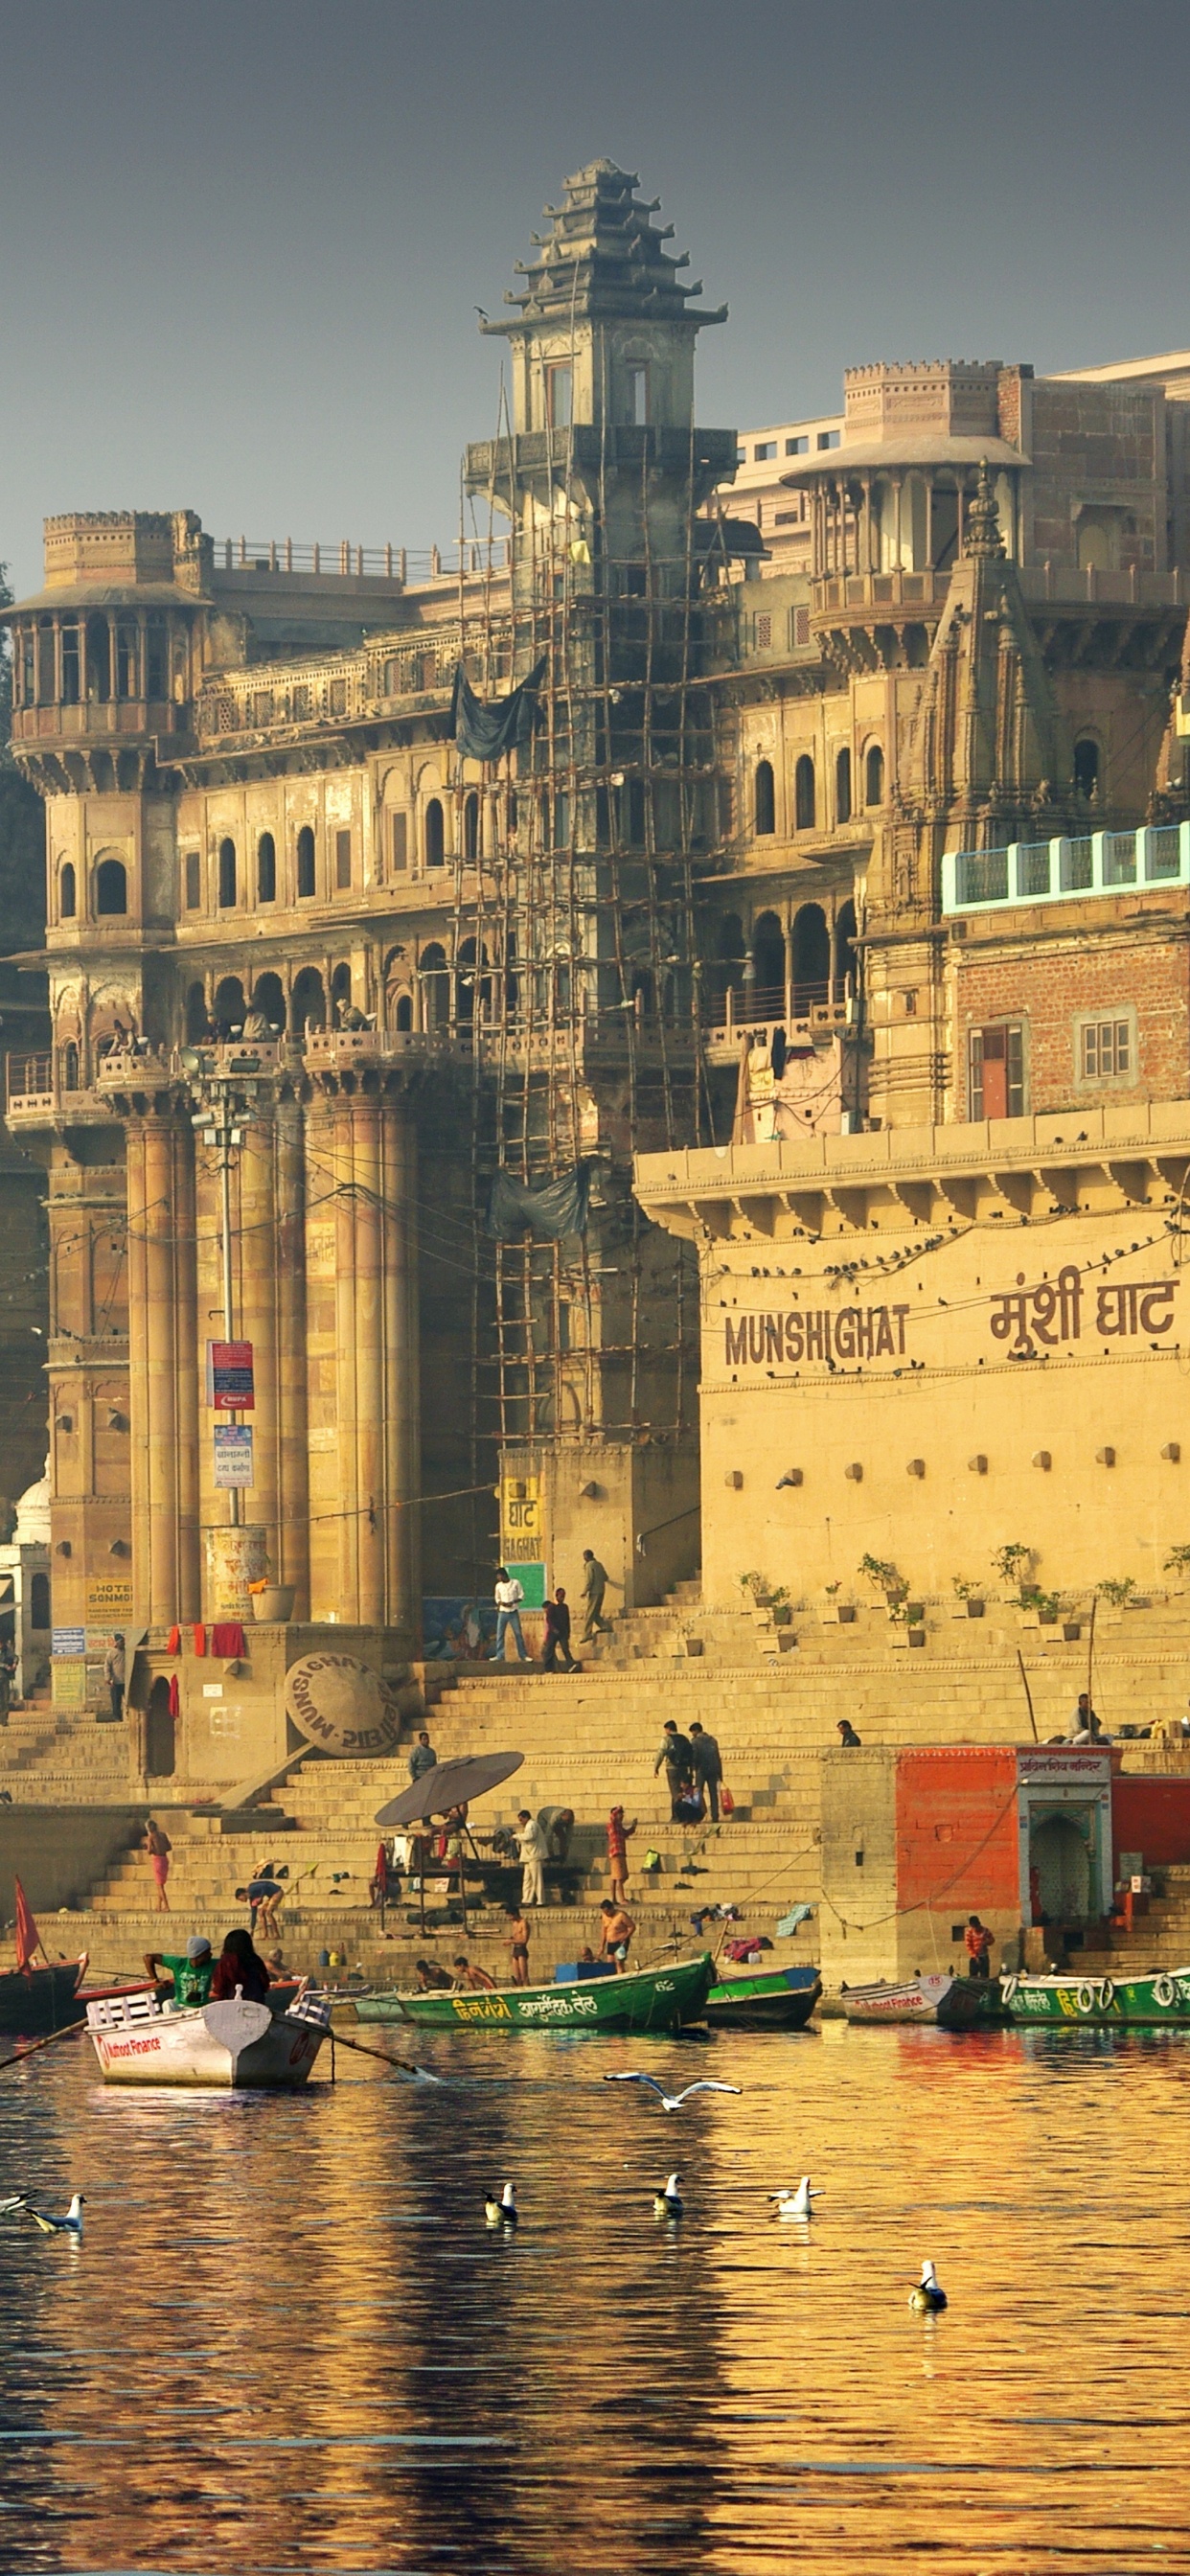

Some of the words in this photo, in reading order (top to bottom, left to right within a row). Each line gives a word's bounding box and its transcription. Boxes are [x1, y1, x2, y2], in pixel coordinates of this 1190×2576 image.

[990, 1265, 1085, 1362] मुंशी
[1096, 1279, 1180, 1336] घाट
[509, 1501, 538, 1528] घाट
[654, 1979, 675, 1992] 62
[571, 1990, 598, 2015] तेल
[891, 1995, 924, 2009] Finance
[129, 2036, 161, 2056] Finance
